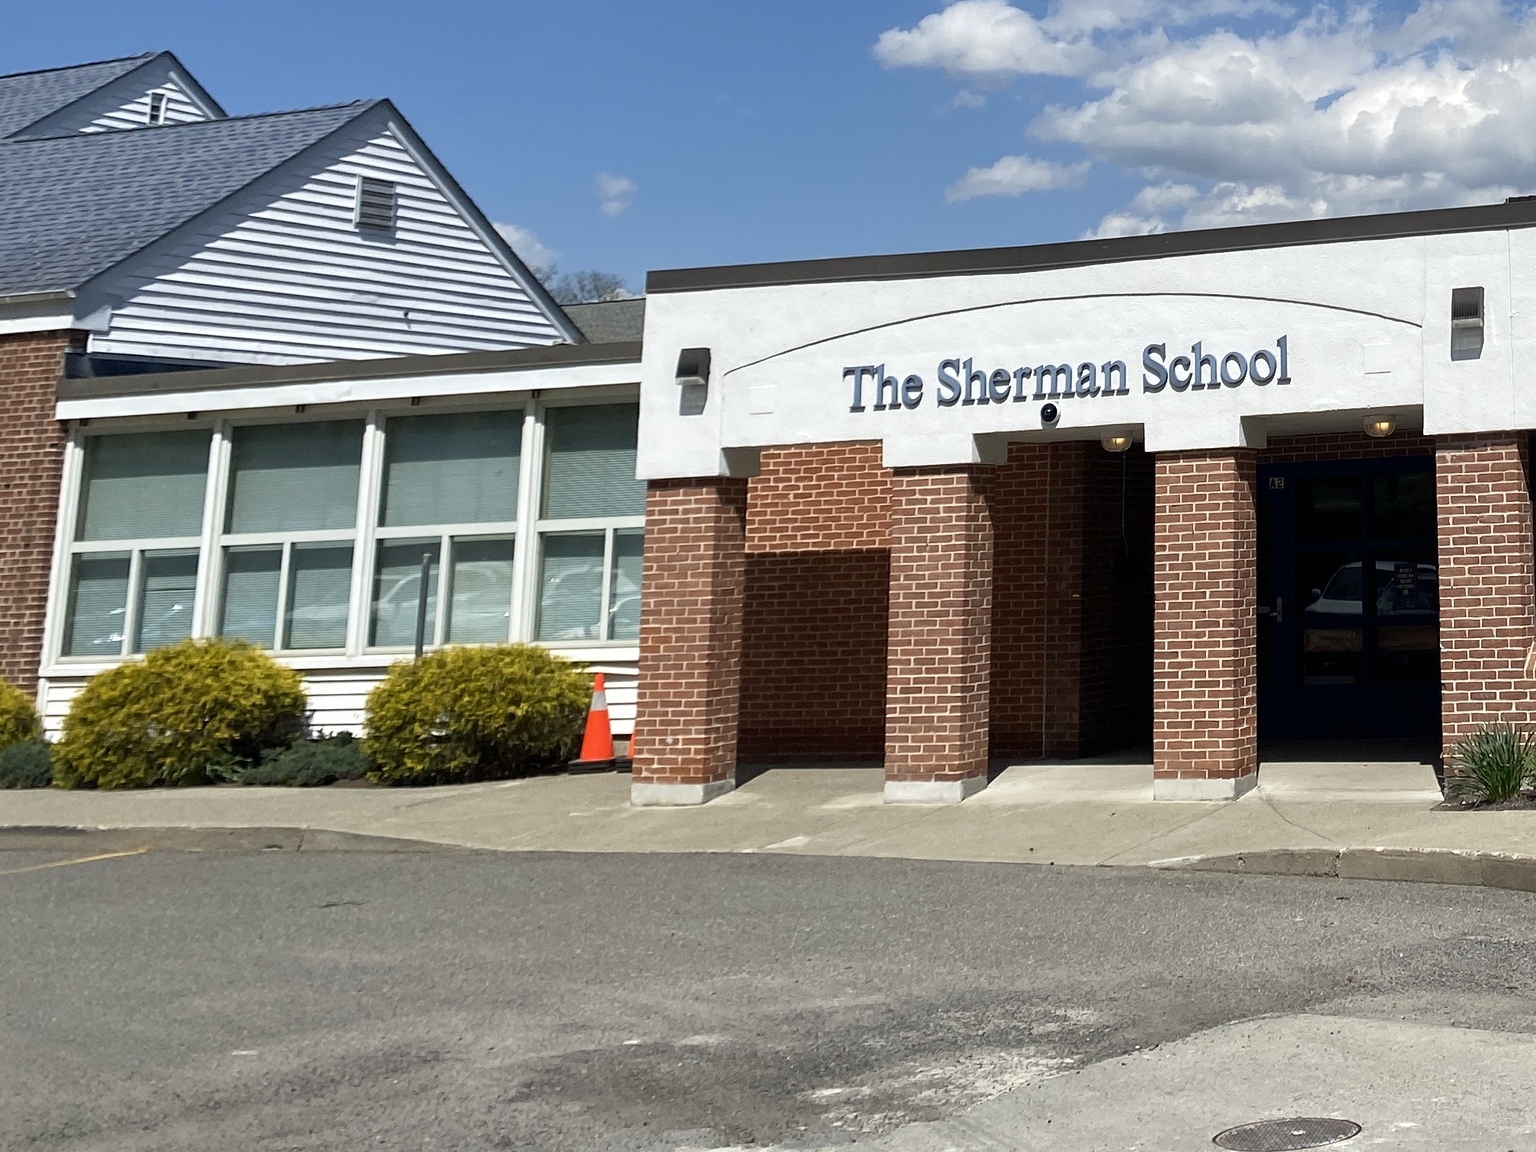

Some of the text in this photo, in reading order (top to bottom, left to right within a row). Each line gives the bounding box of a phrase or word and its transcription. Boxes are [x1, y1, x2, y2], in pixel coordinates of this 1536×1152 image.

[843, 335, 1292, 413] The Sherman School
[1269, 478, 1283, 489] A2
